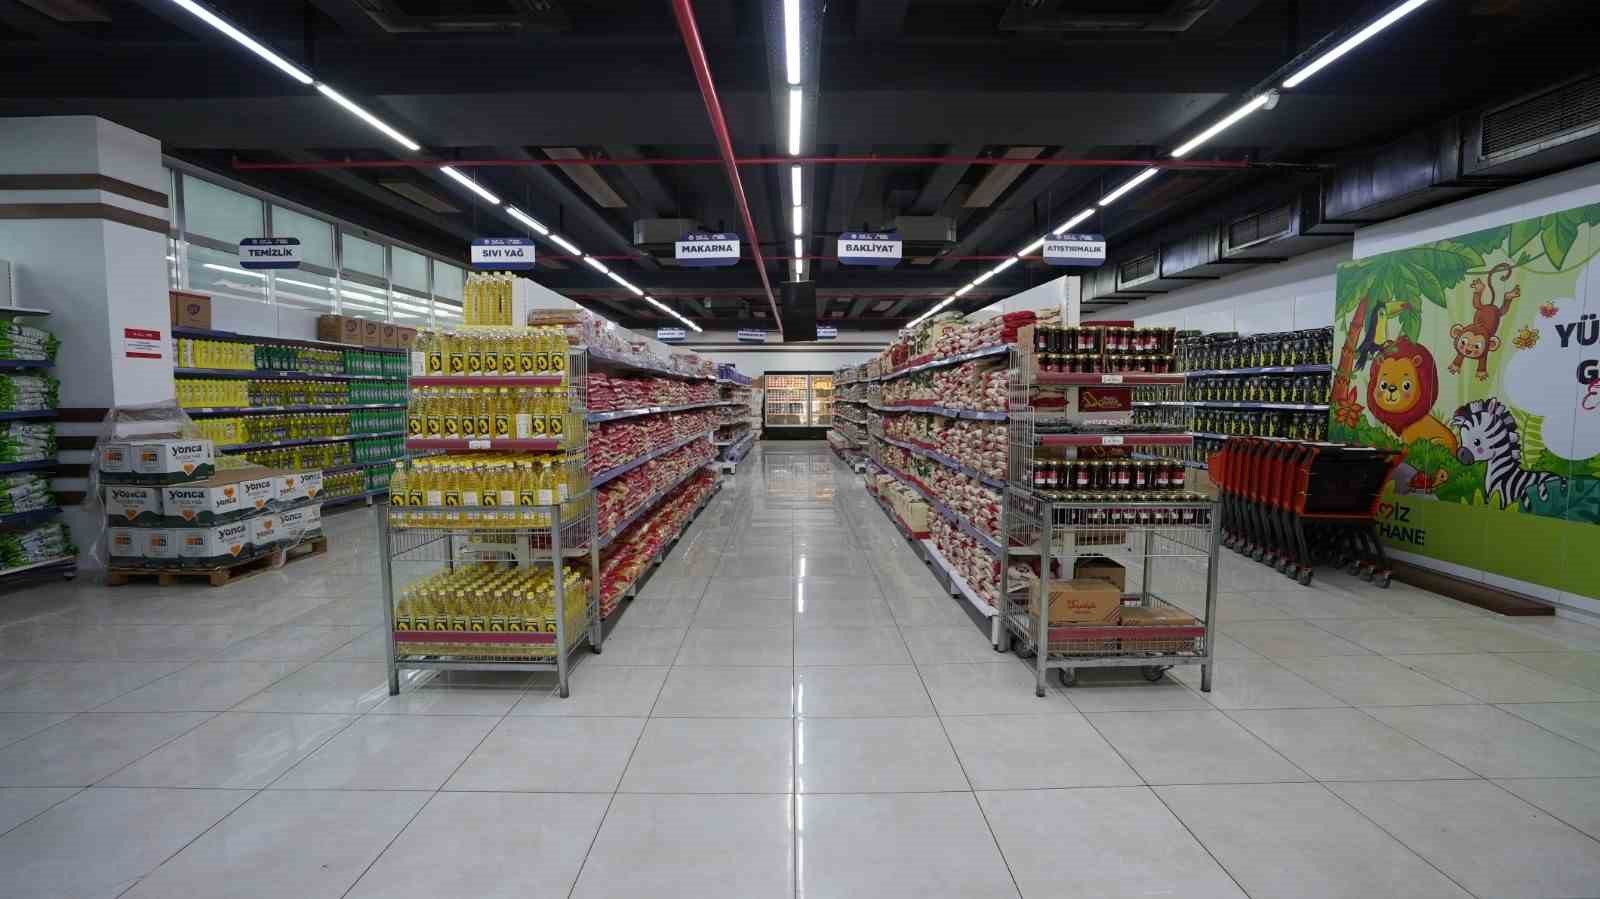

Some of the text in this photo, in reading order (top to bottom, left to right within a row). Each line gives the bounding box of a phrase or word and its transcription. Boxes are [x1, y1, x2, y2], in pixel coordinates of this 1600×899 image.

[247, 247, 293, 257] TEMİZLİK
[482, 248, 524, 257] SIVI YAĞ
[681, 244, 733, 253] MAKARNA
[845, 243, 894, 252] BAKLİYAT
[171, 443, 202, 456] yonca
[244, 480, 271, 492] yonca
[111, 488, 147, 499] yonca
[168, 490, 204, 500] yonca
[216, 496, 237, 507] yonca
[218, 524, 246, 539] yonca
[1376, 521, 1426, 546] HANE
